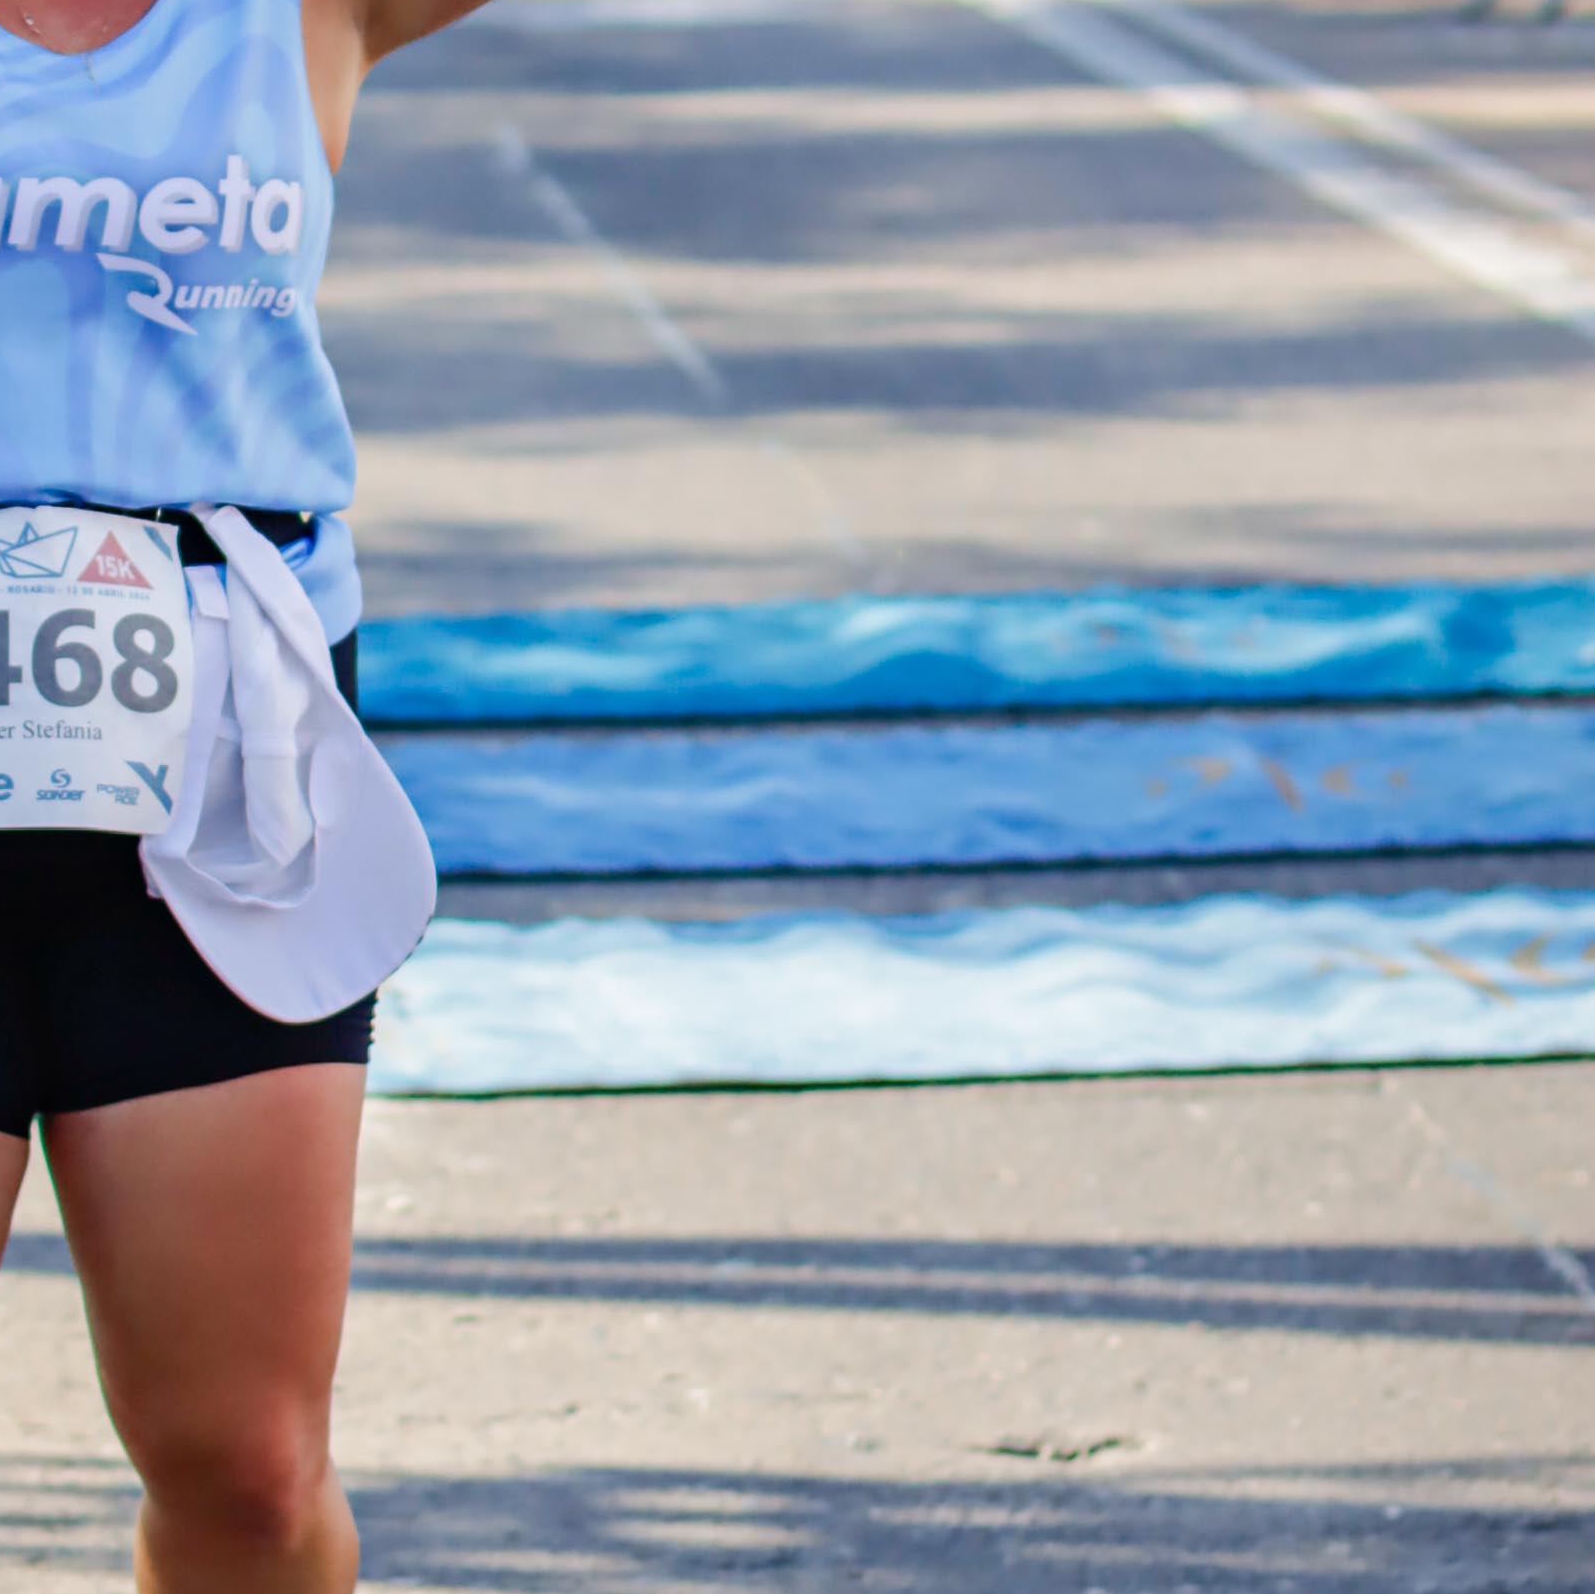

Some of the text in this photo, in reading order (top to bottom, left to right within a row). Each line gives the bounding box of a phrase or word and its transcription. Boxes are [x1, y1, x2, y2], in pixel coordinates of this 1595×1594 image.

[96, 253, 297, 336] Running
[97, 554, 136, 581] 15K
[8, 584, 55, 595] ROSARIO
[22, 720, 103, 741] Stefania
